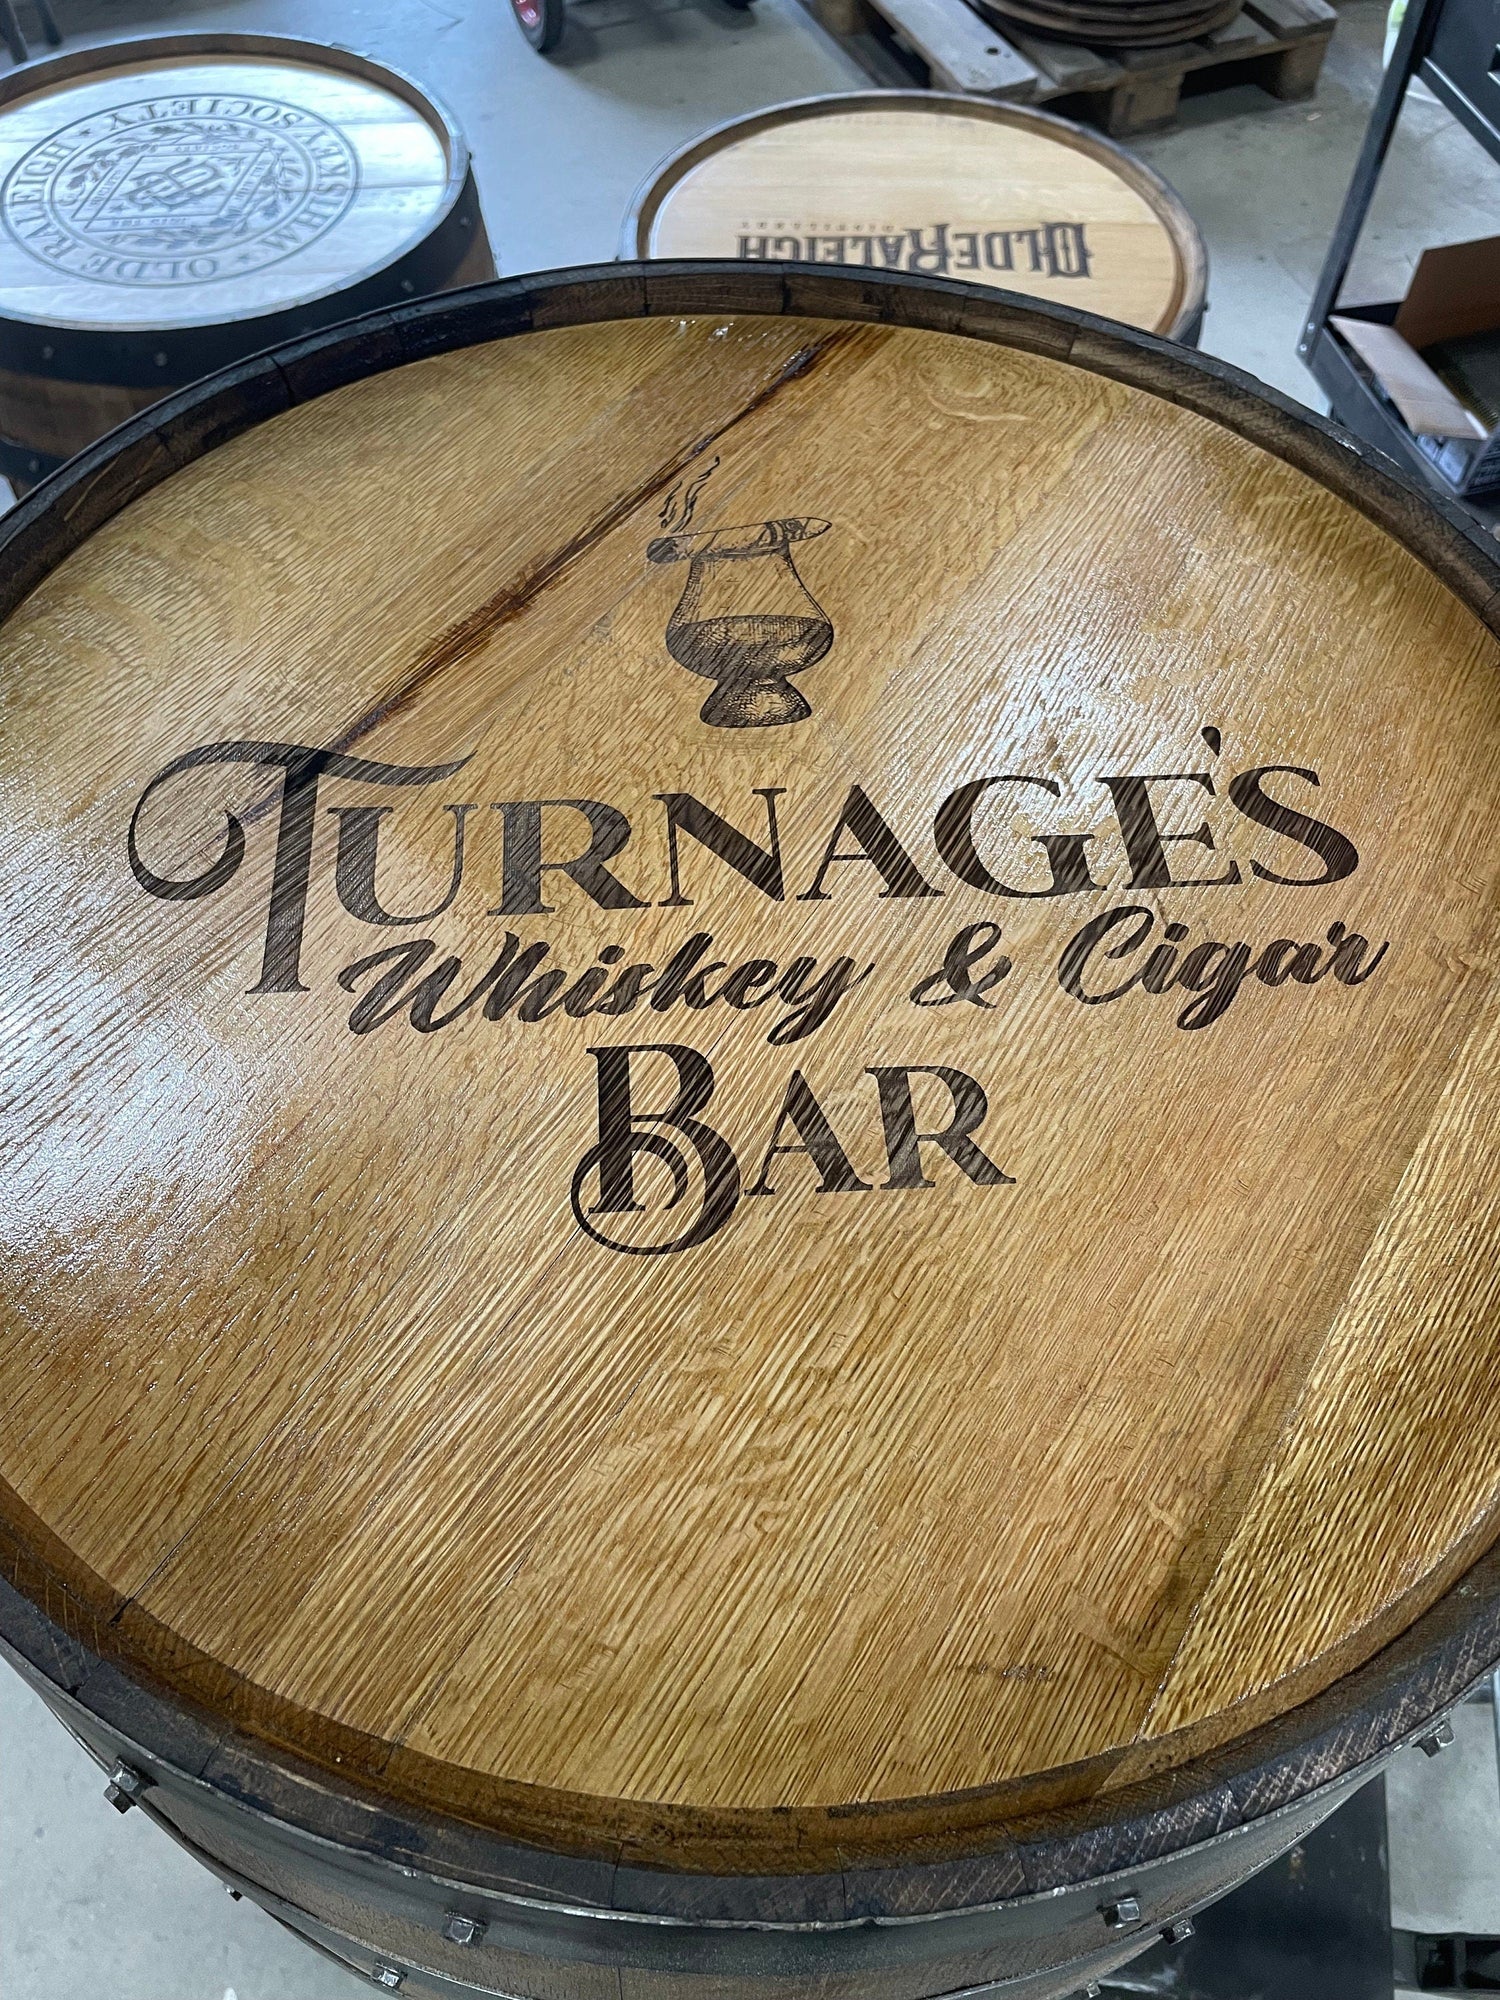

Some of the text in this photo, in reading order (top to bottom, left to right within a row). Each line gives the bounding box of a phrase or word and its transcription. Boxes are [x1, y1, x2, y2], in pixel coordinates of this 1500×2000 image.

[109, 99, 306, 132] SOCIETY
[11, 140, 81, 261] RALEIGH
[263, 130, 349, 251] WHISKEY
[80, 256, 217, 282] OLDE
[128, 726, 1360, 995] TURNAGE'S
[338, 905, 1390, 1046] Whiskey & Cigar
[571, 1042, 1017, 1255] BAR
